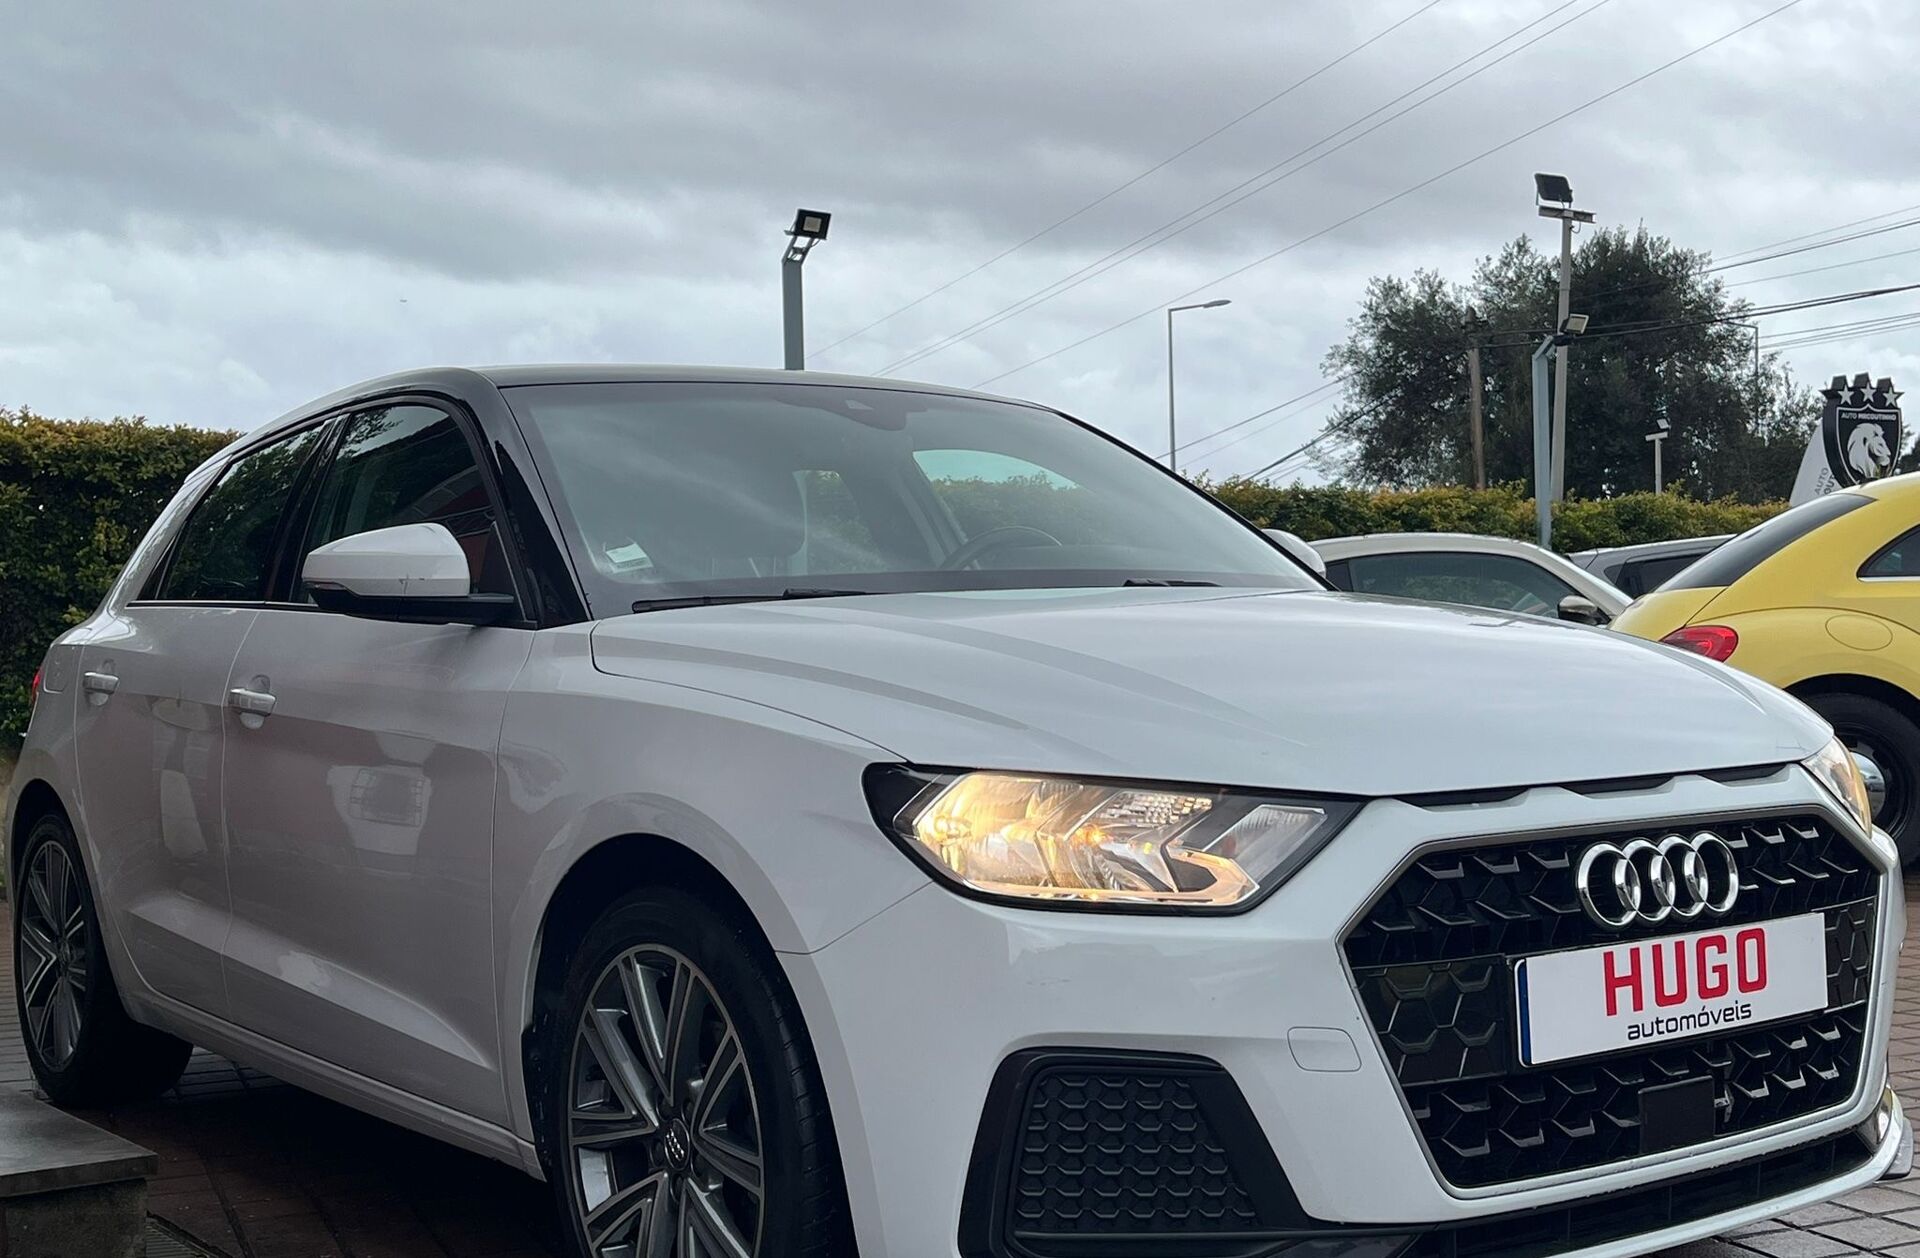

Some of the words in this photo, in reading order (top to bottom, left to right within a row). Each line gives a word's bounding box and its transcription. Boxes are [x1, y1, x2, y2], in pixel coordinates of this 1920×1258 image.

[1841, 412, 1857, 420] AUTO
[1814, 467, 1829, 495] AUTO
[1603, 927, 1767, 1016] HUGO
[1627, 1000, 1752, 1040] automóveis
